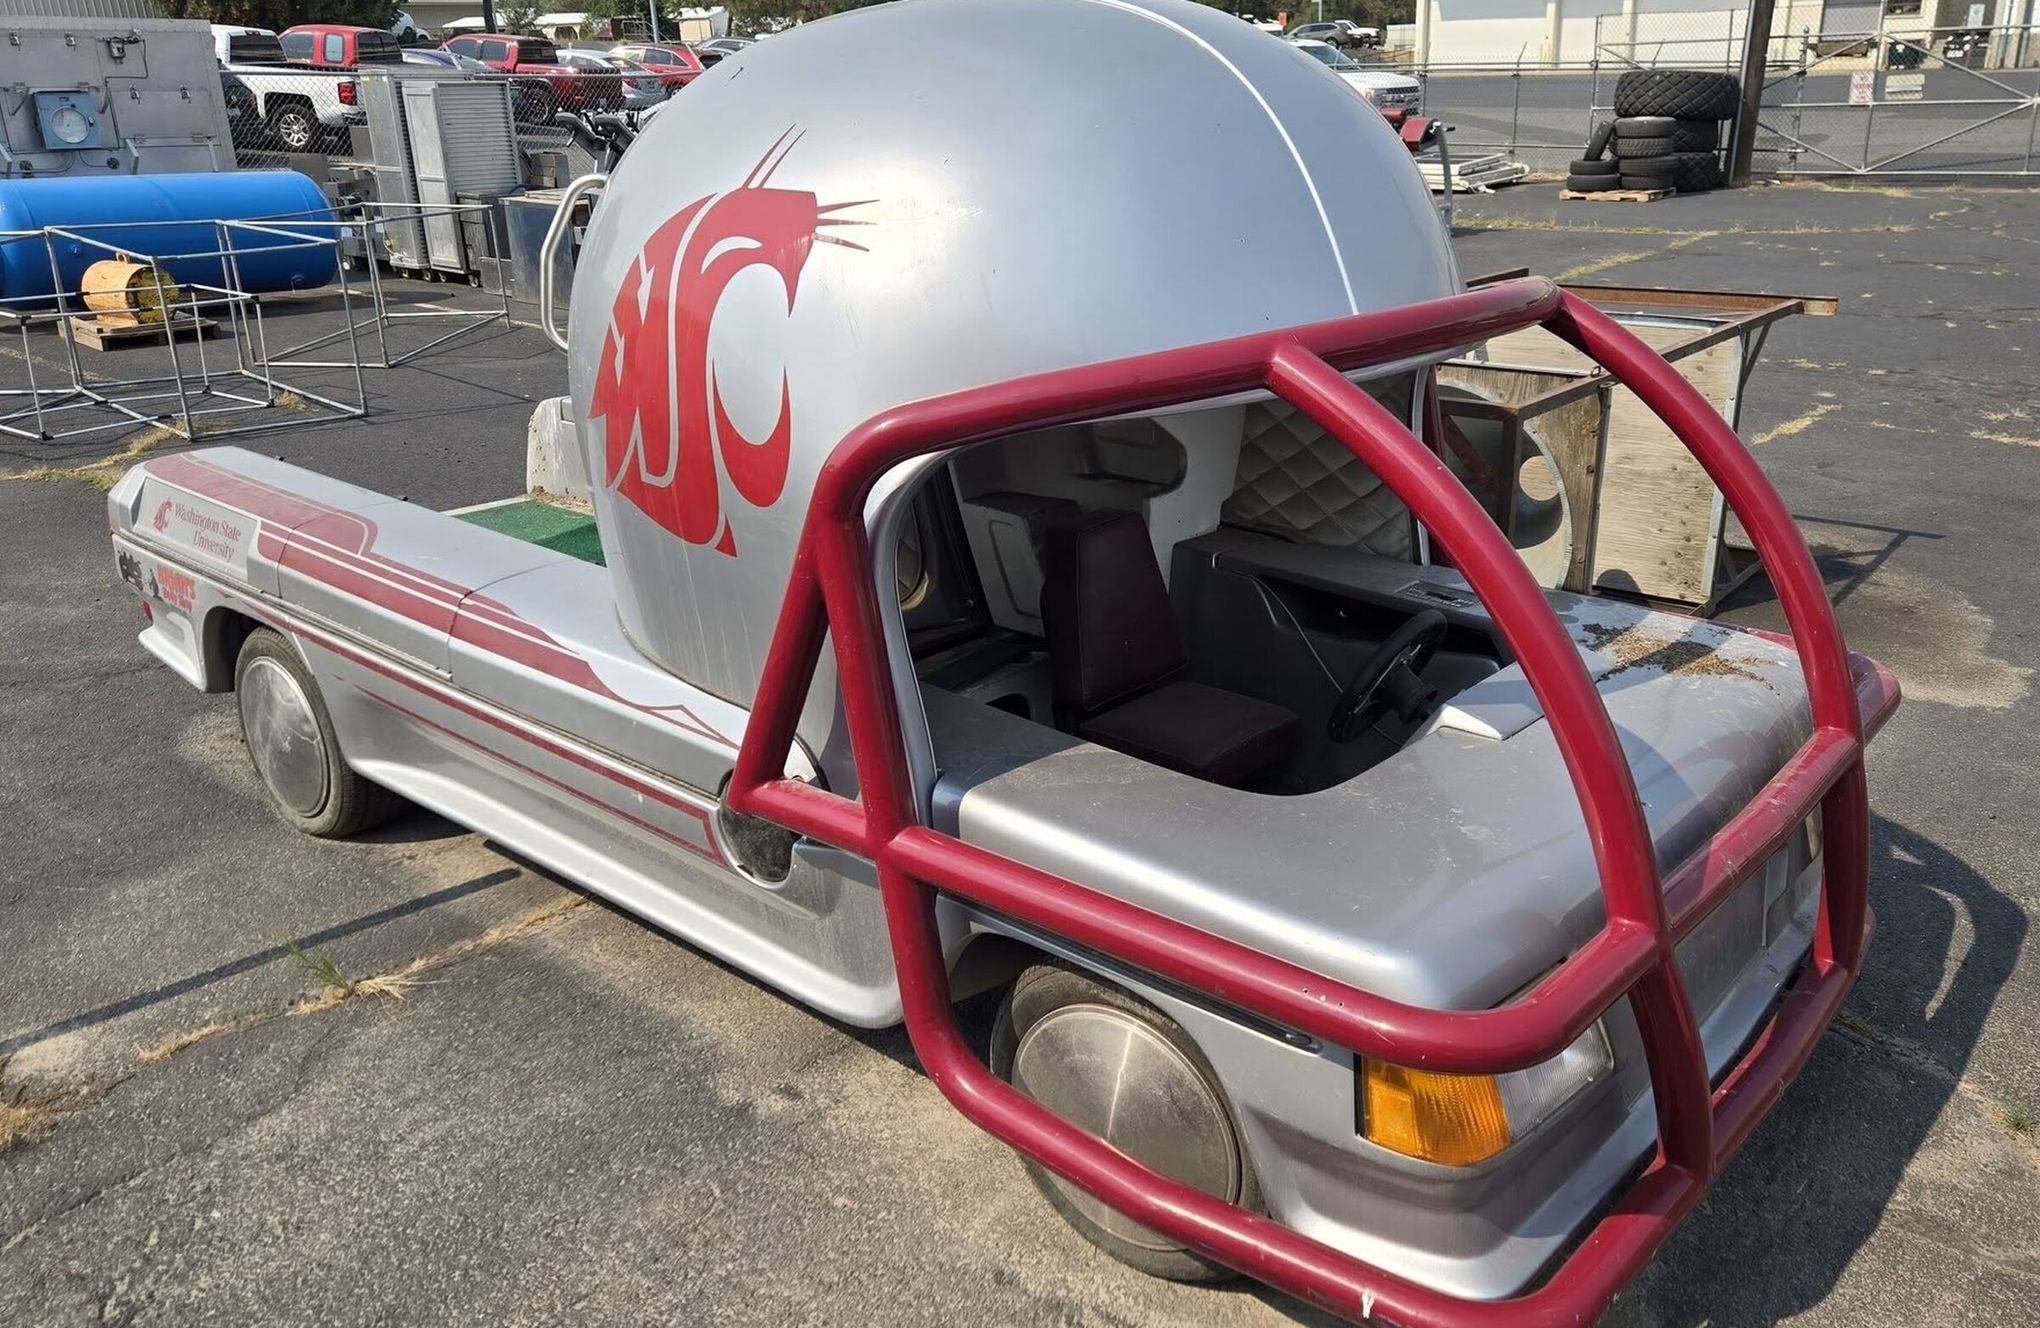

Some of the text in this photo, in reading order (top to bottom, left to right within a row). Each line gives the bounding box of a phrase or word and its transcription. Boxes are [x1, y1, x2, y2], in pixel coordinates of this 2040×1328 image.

[175, 502, 220, 533] Washington
[221, 520, 241, 542] State
[193, 530, 235, 563] University
